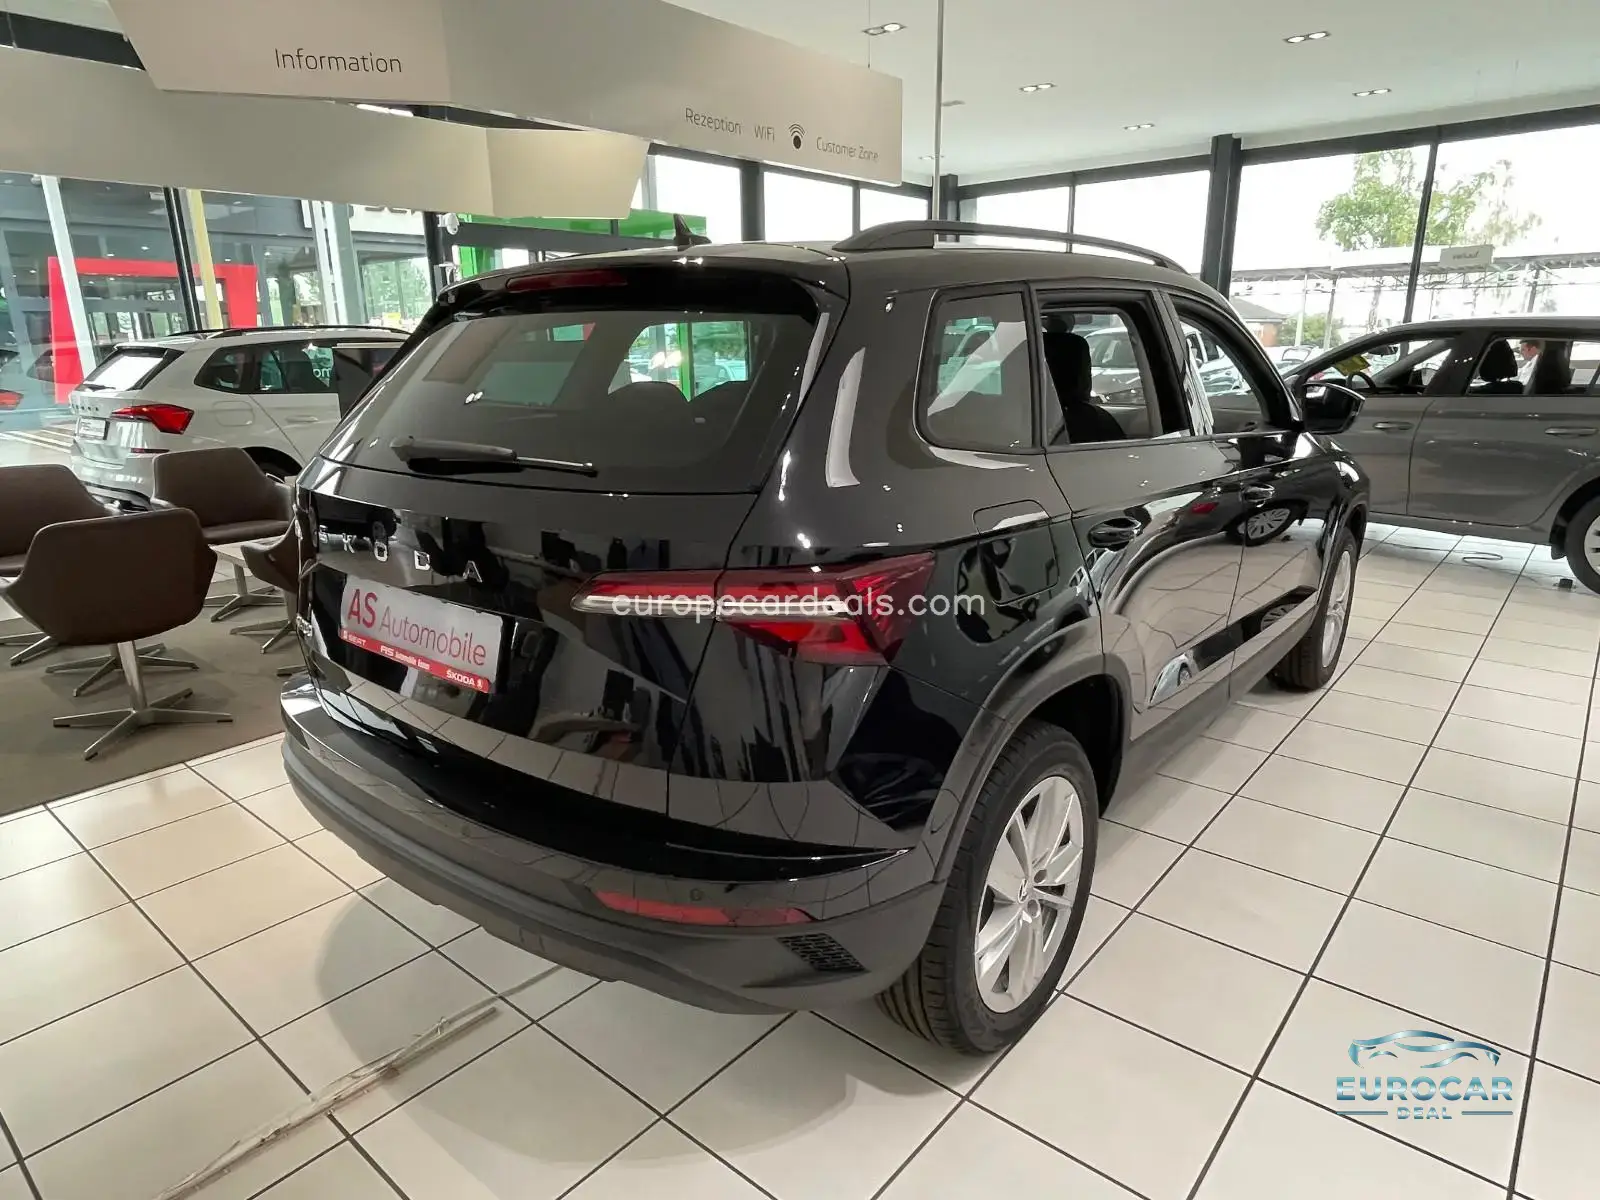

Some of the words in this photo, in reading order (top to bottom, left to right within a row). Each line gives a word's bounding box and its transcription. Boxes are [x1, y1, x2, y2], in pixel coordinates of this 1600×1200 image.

[275, 48, 404, 74] Information
[684, 107, 742, 136] Rezeption
[754, 124, 776, 142] WiFi
[816, 136, 857, 158] Customer
[858, 145, 879, 163] Zone
[347, 588, 378, 629] AS
[379, 605, 487, 667] Automobile
